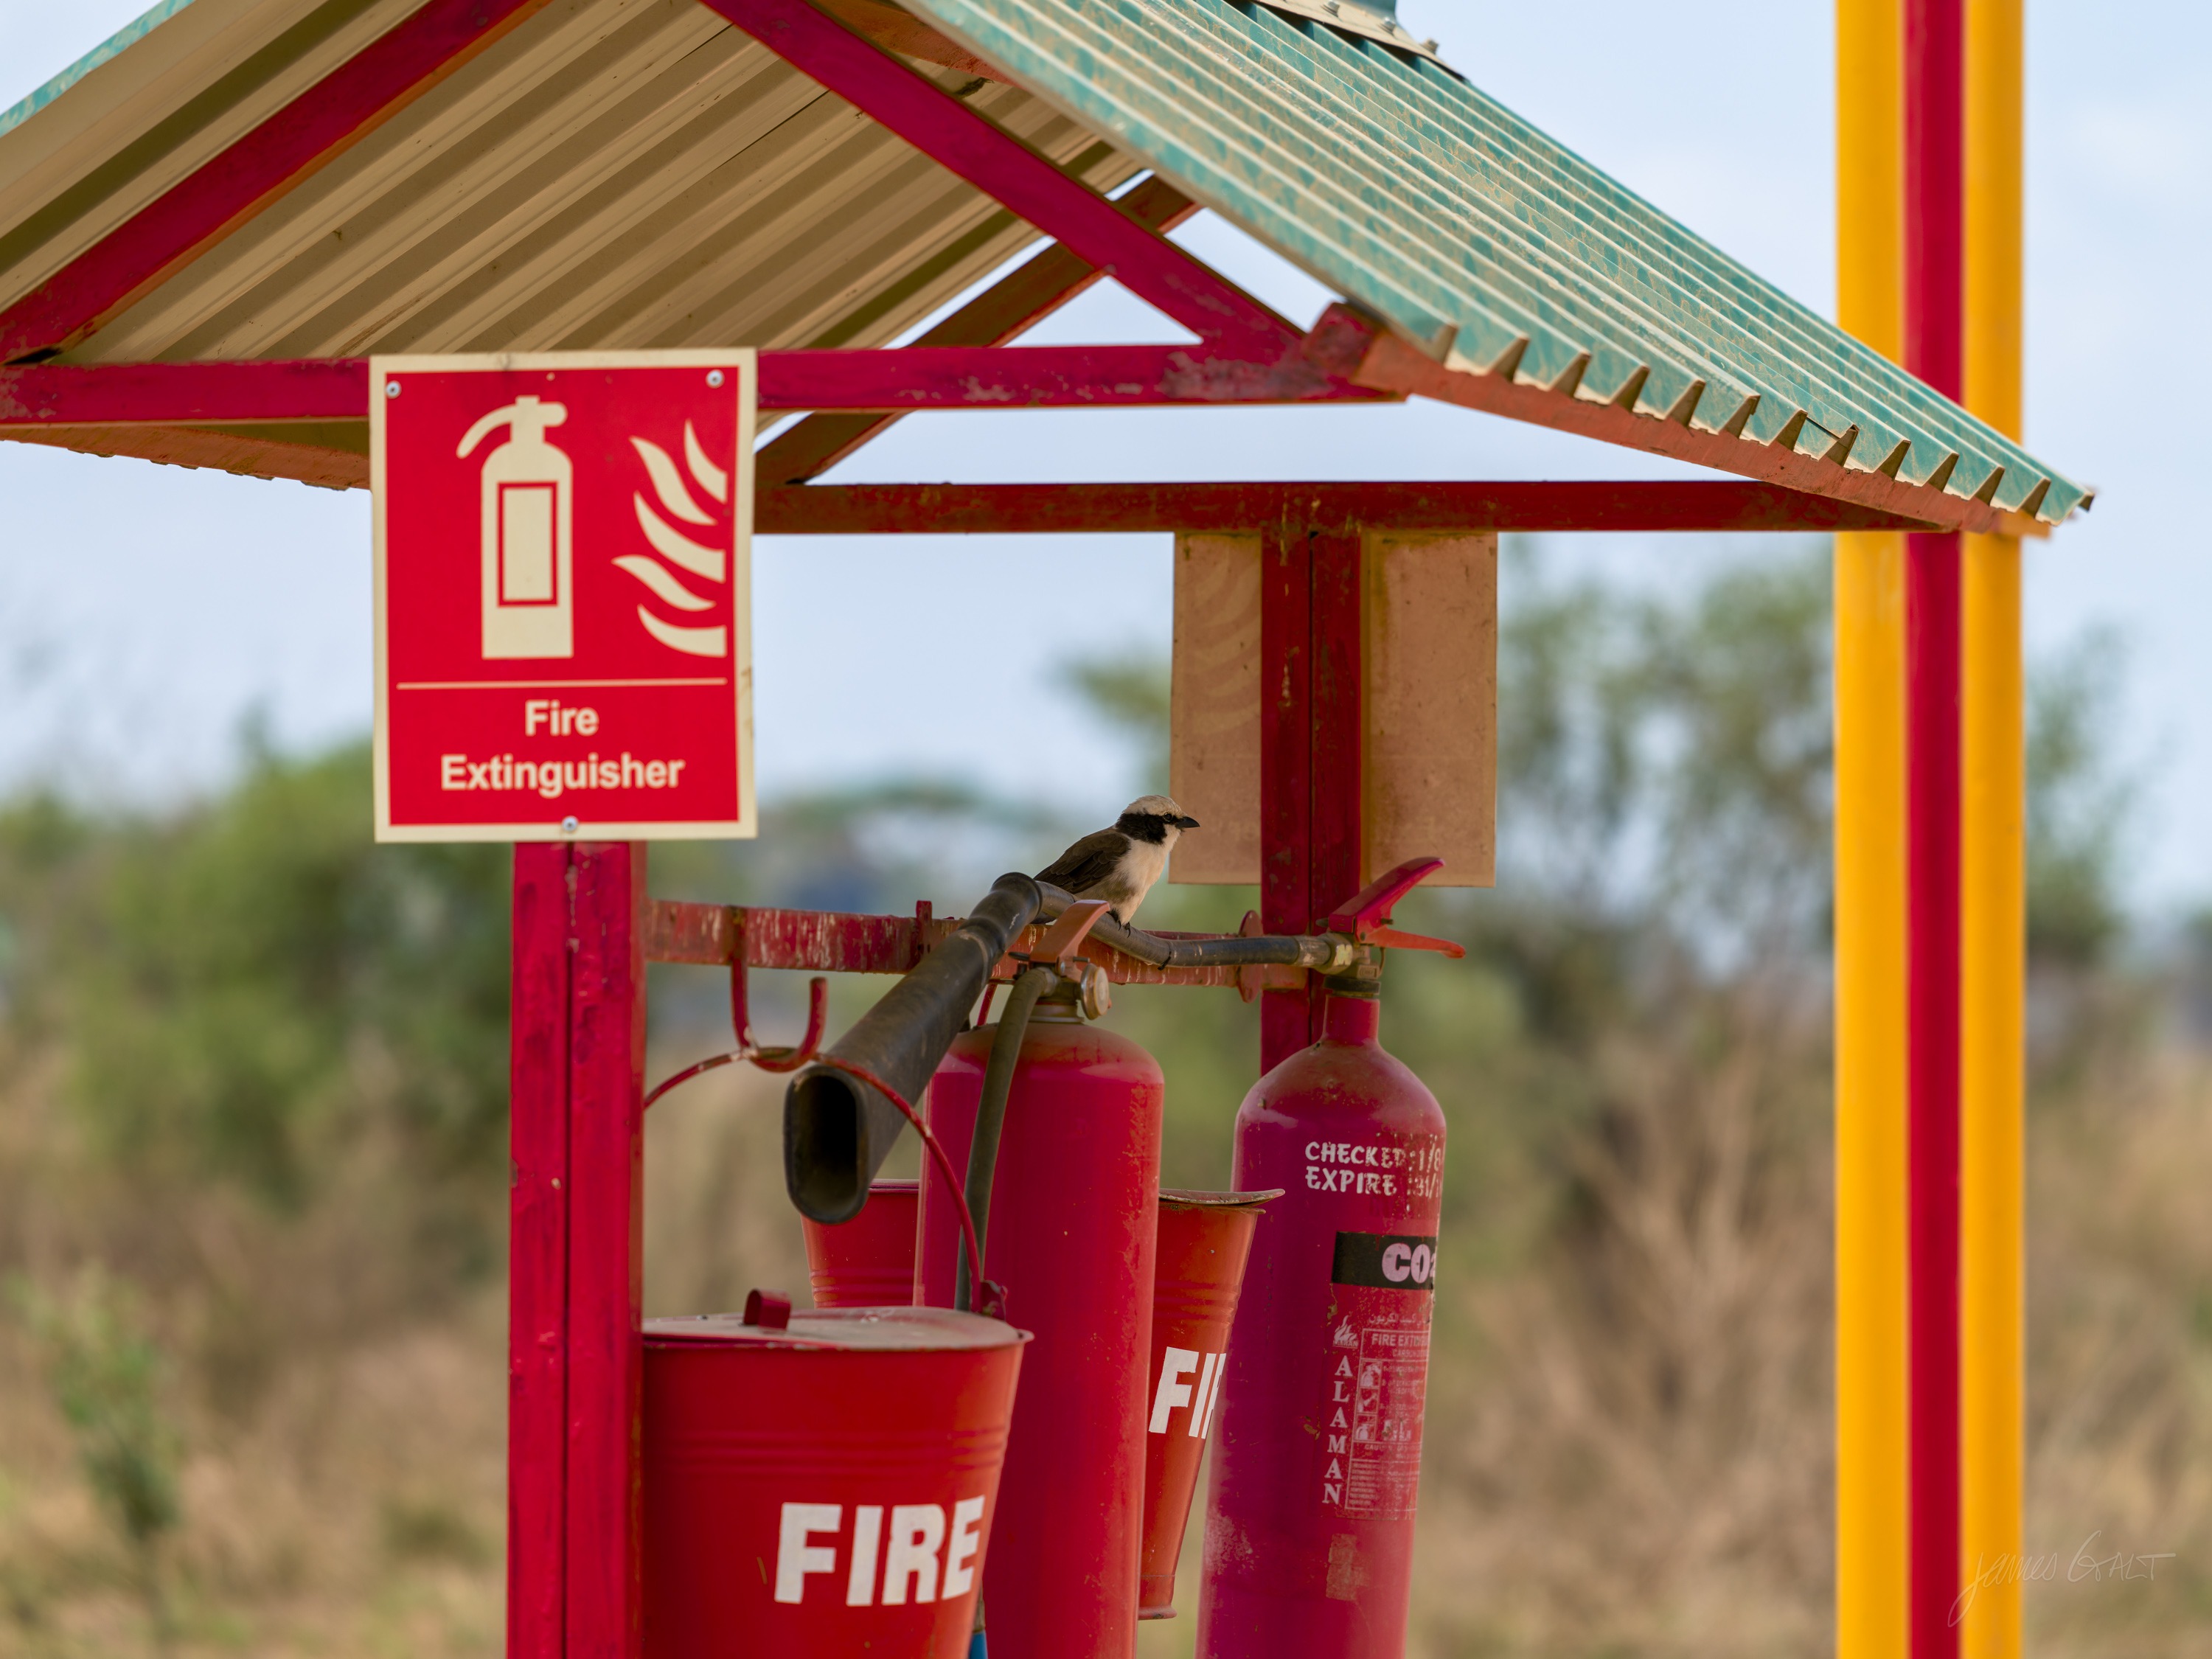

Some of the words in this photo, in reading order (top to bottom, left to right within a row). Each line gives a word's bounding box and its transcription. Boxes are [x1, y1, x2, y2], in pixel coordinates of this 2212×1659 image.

[525, 700, 599, 737] Fire
[441, 751, 686, 799] Extinguisher
[1305, 1166, 1397, 1196] EXPIRE
[1371, 1333, 1397, 1346] FIRE
[1322, 1355, 1353, 1505] ALAMAN
[774, 1495, 985, 1607] FIRE
